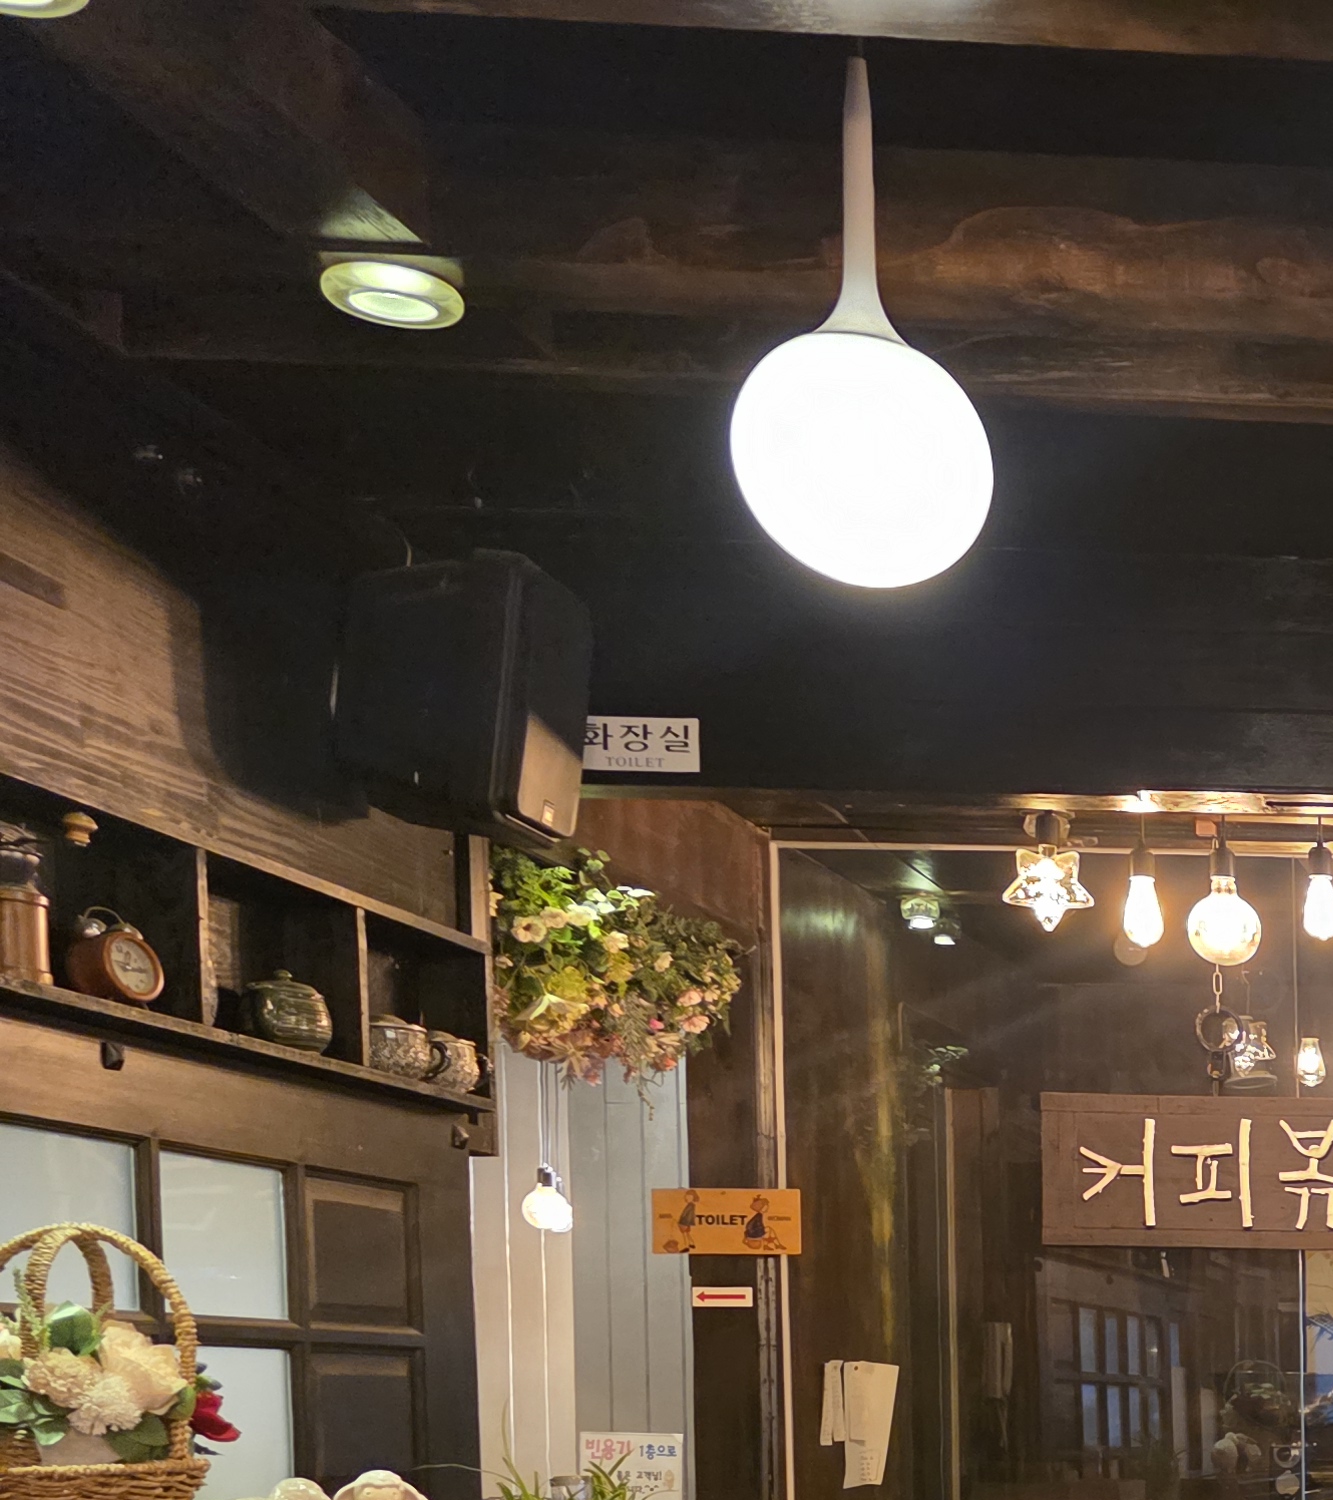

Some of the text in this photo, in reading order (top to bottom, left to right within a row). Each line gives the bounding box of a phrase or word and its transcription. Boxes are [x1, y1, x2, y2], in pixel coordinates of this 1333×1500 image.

[584, 722, 690, 753] 화장실
[605, 756, 665, 768] TOILET
[696, 1214, 748, 1226] TOILET
[585, 1438, 677, 1461] 빈용기 1층으로
